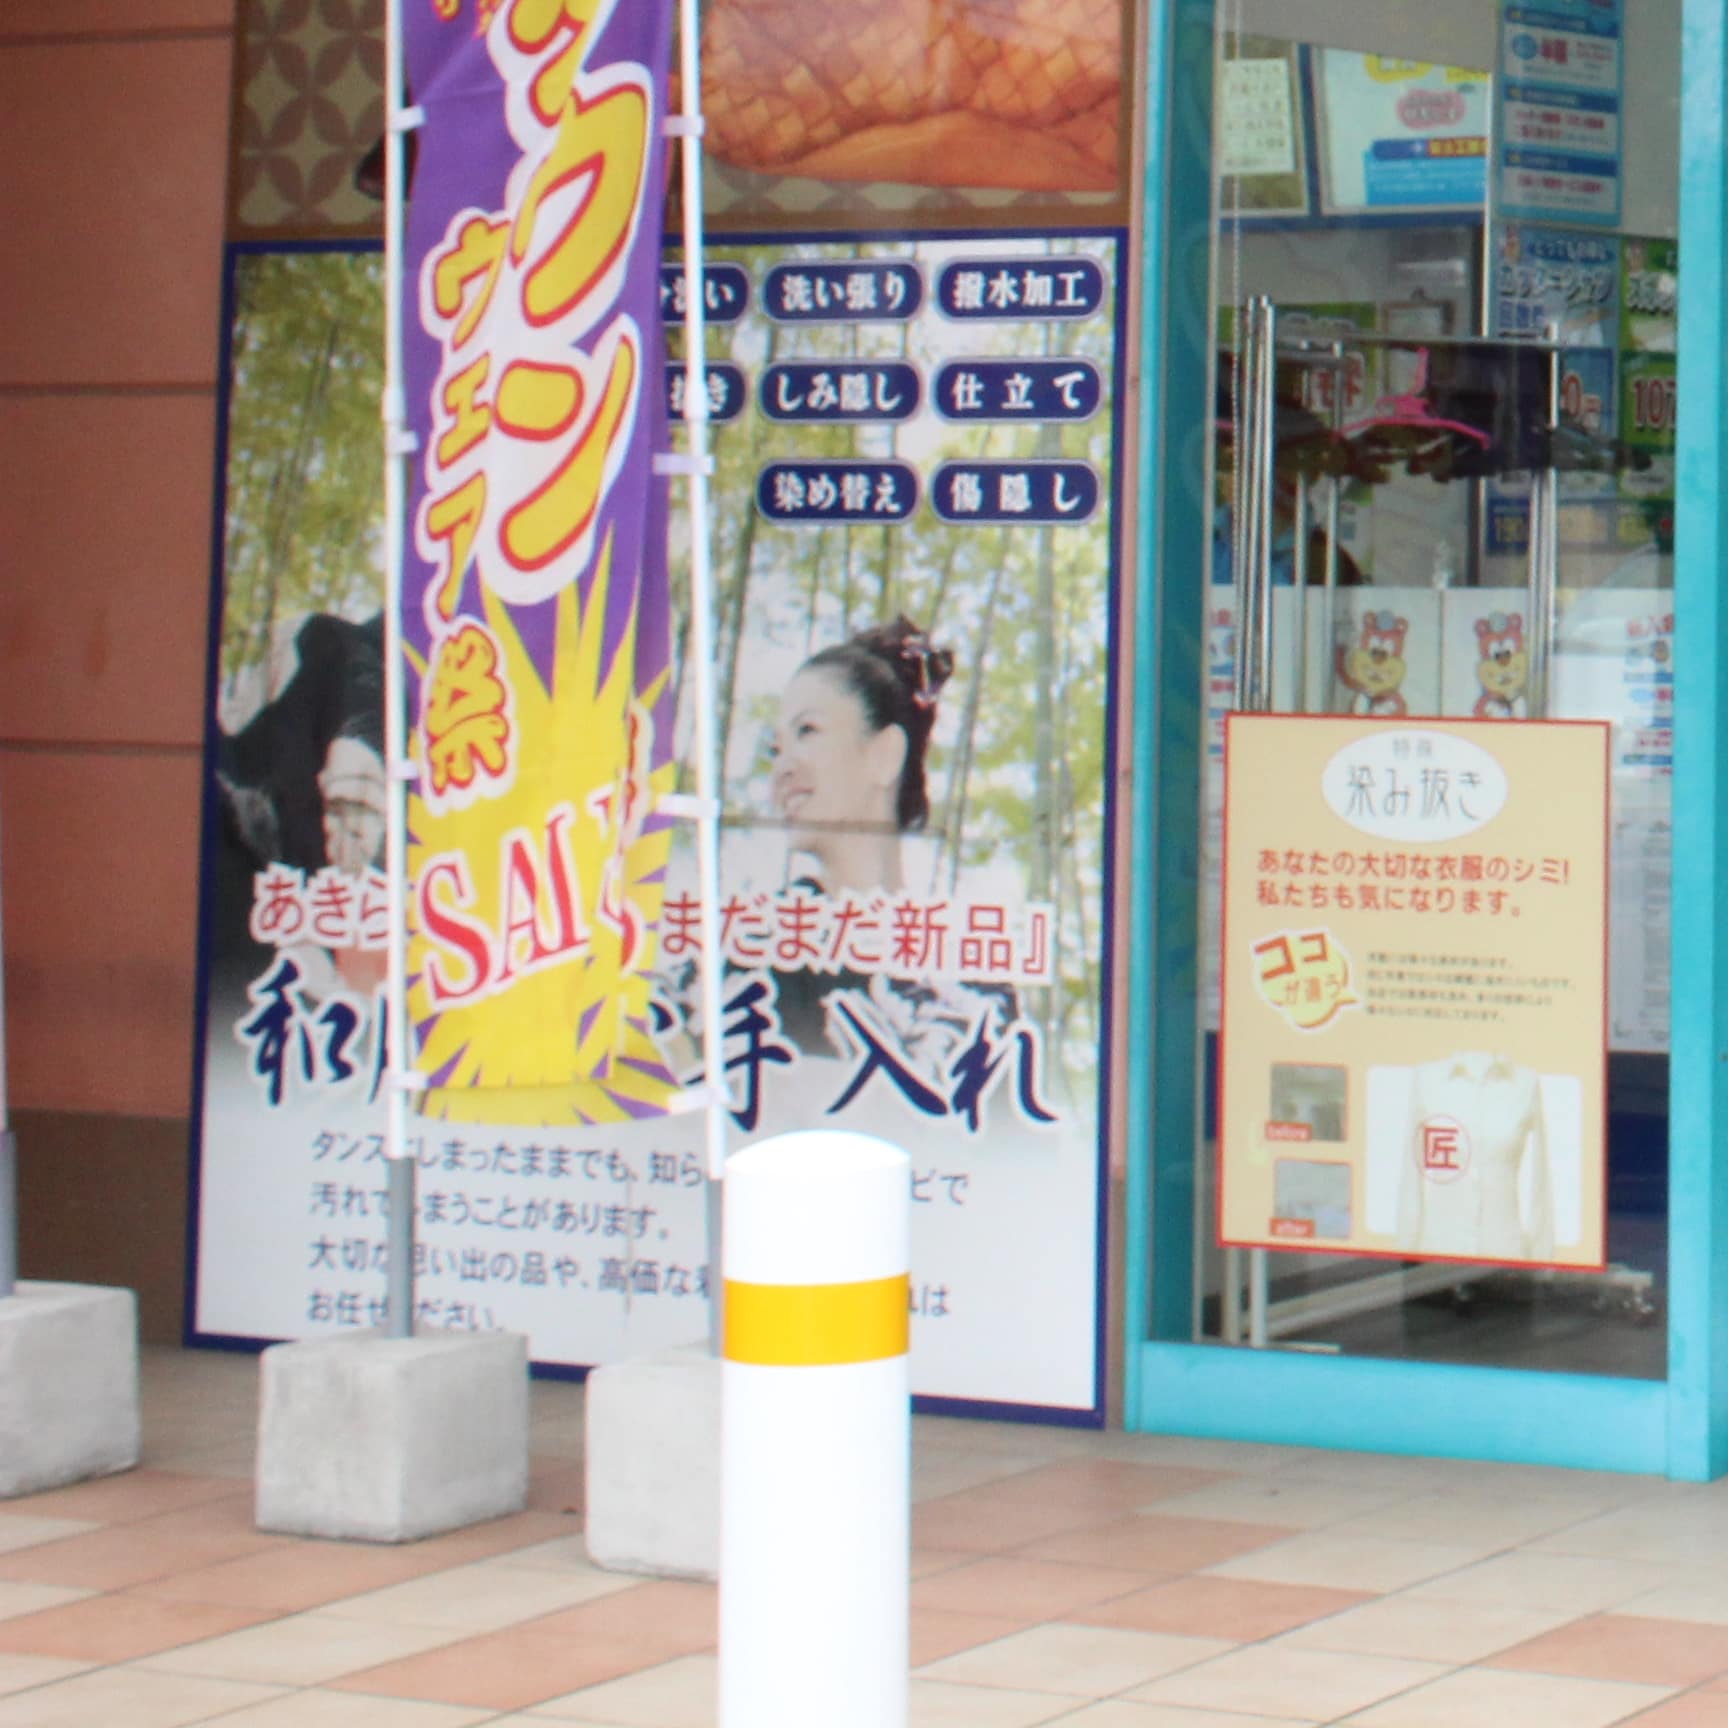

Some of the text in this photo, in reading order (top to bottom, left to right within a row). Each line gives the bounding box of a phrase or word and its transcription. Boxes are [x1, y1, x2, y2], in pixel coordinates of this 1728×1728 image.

[780, 272, 908, 313] 洗い張り
[953, 270, 1088, 311] 撥水加工
[775, 371, 901, 411] しみ隠し
[951, 371, 1086, 411] 仕立て
[773, 472, 902, 514] 染め替え
[1345, 763, 1483, 822] 染み抜き
[1257, 848, 1571, 885] あなたの大切な衣服のシミ!
[1256, 879, 1523, 918] 私たちも気になります。
[1254, 930, 1329, 983] ココ
[1424, 1125, 1460, 1171] 匠
